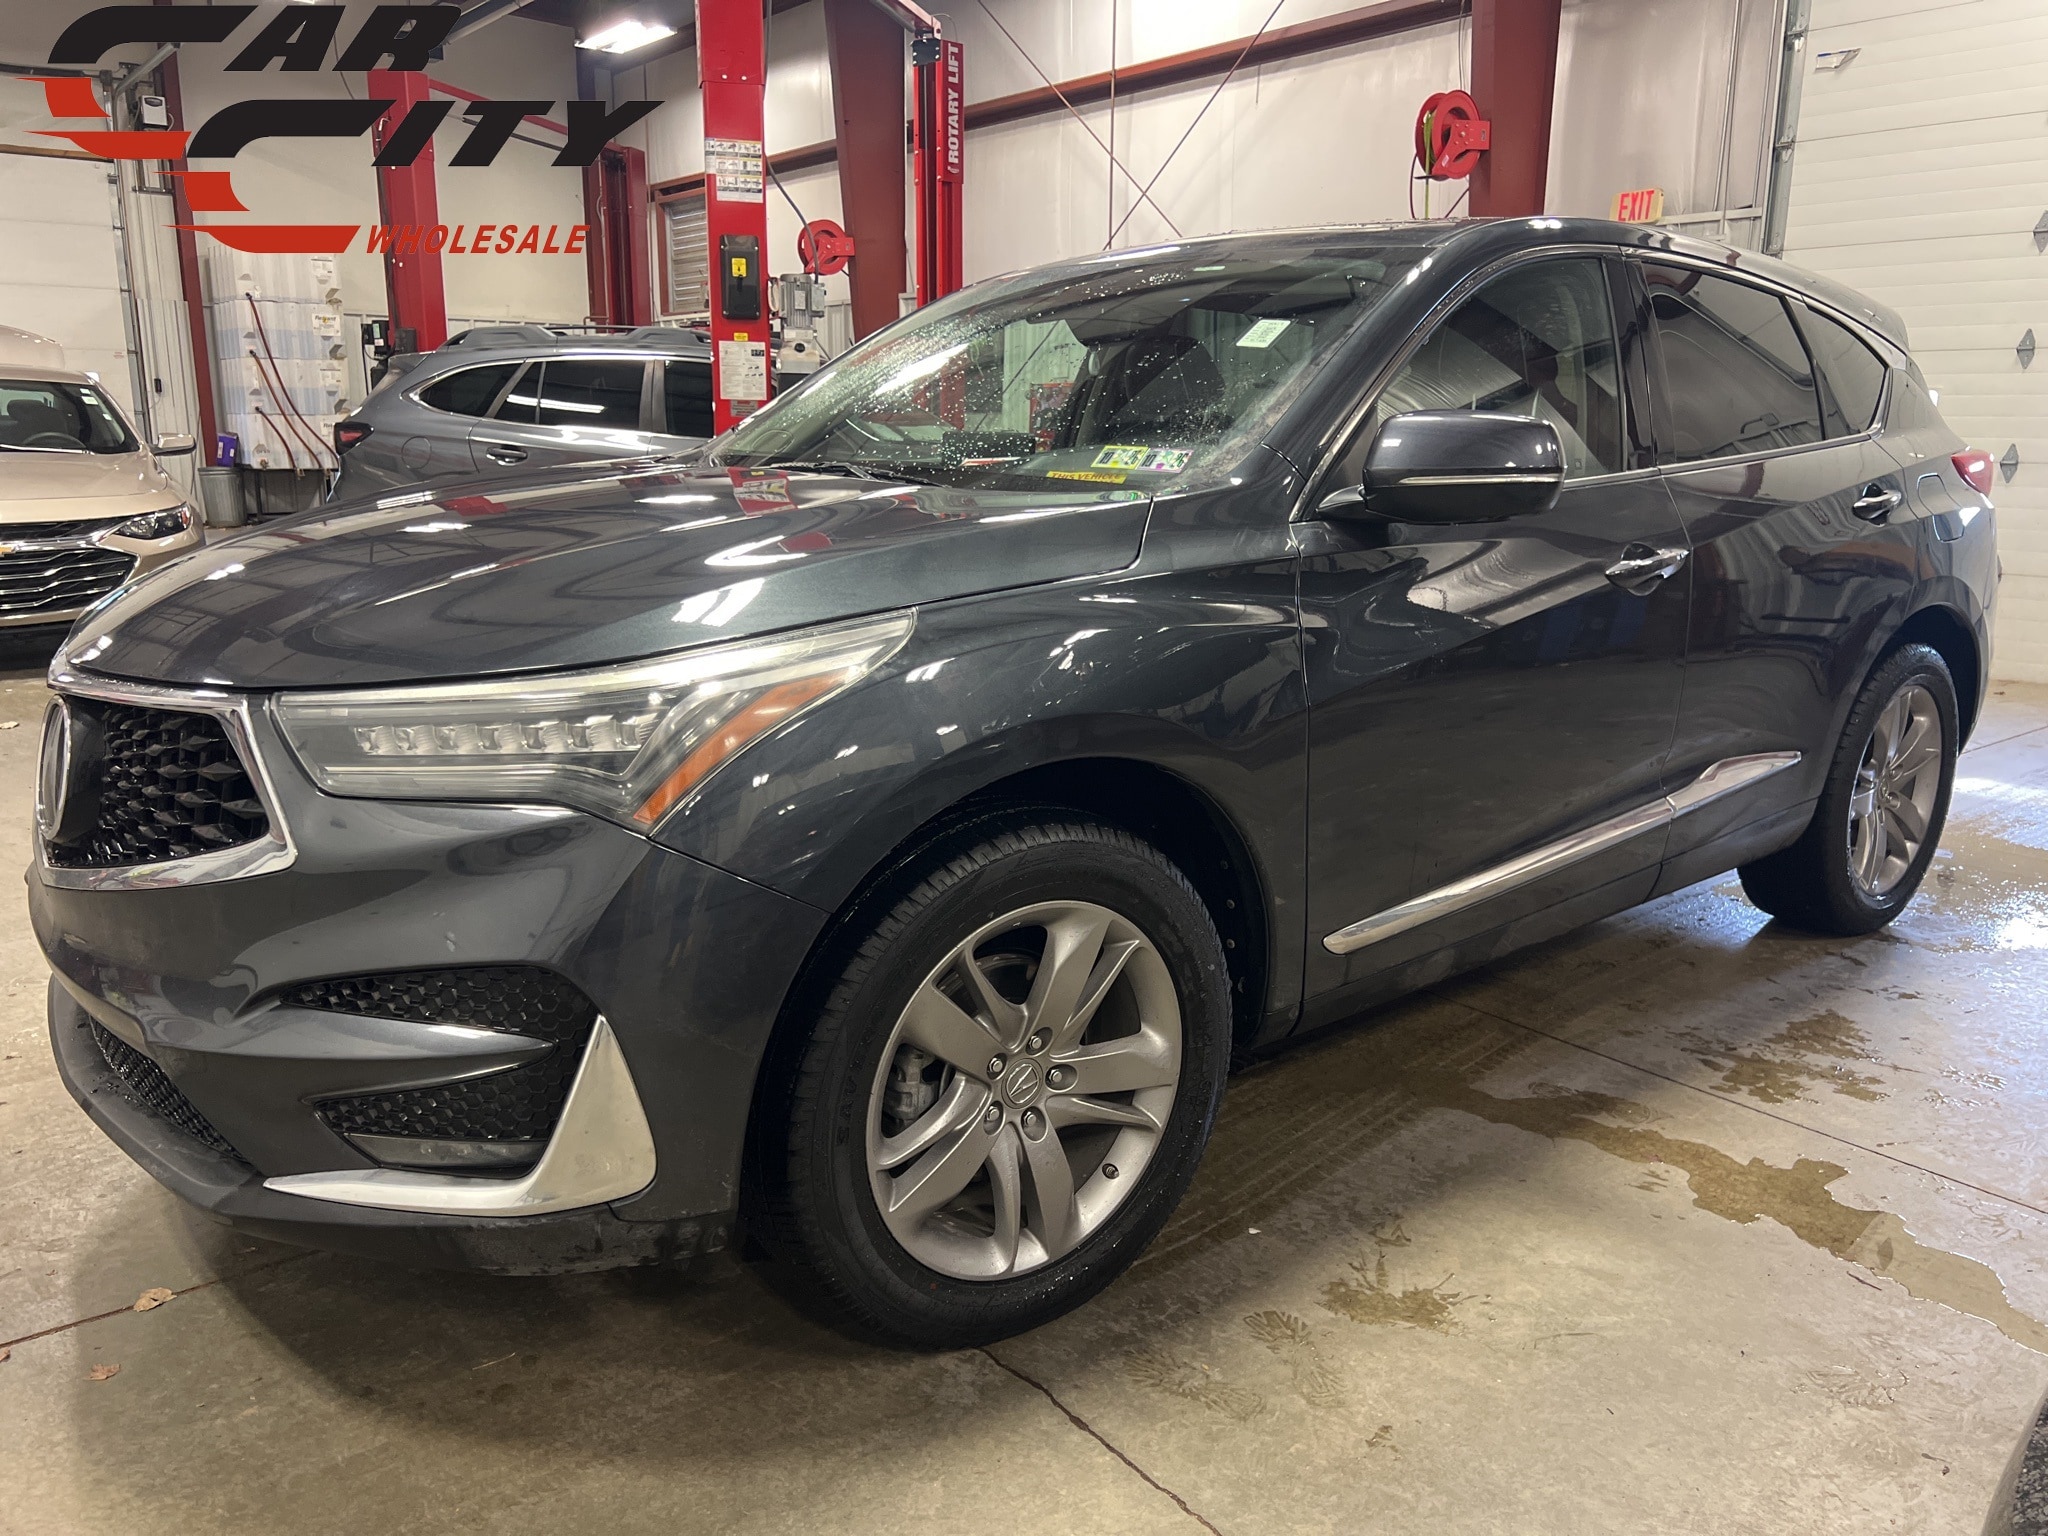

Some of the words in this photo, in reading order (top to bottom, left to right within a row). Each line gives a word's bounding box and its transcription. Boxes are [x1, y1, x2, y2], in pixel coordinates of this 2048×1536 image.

[947, 42, 960, 84] LIFT
[947, 87, 960, 164] ROTARY
[1617, 189, 1655, 222] EXIT
[1098, 451, 1115, 464] 10
[1141, 454, 1157, 467] 10
[1051, 472, 1075, 480] THIS
